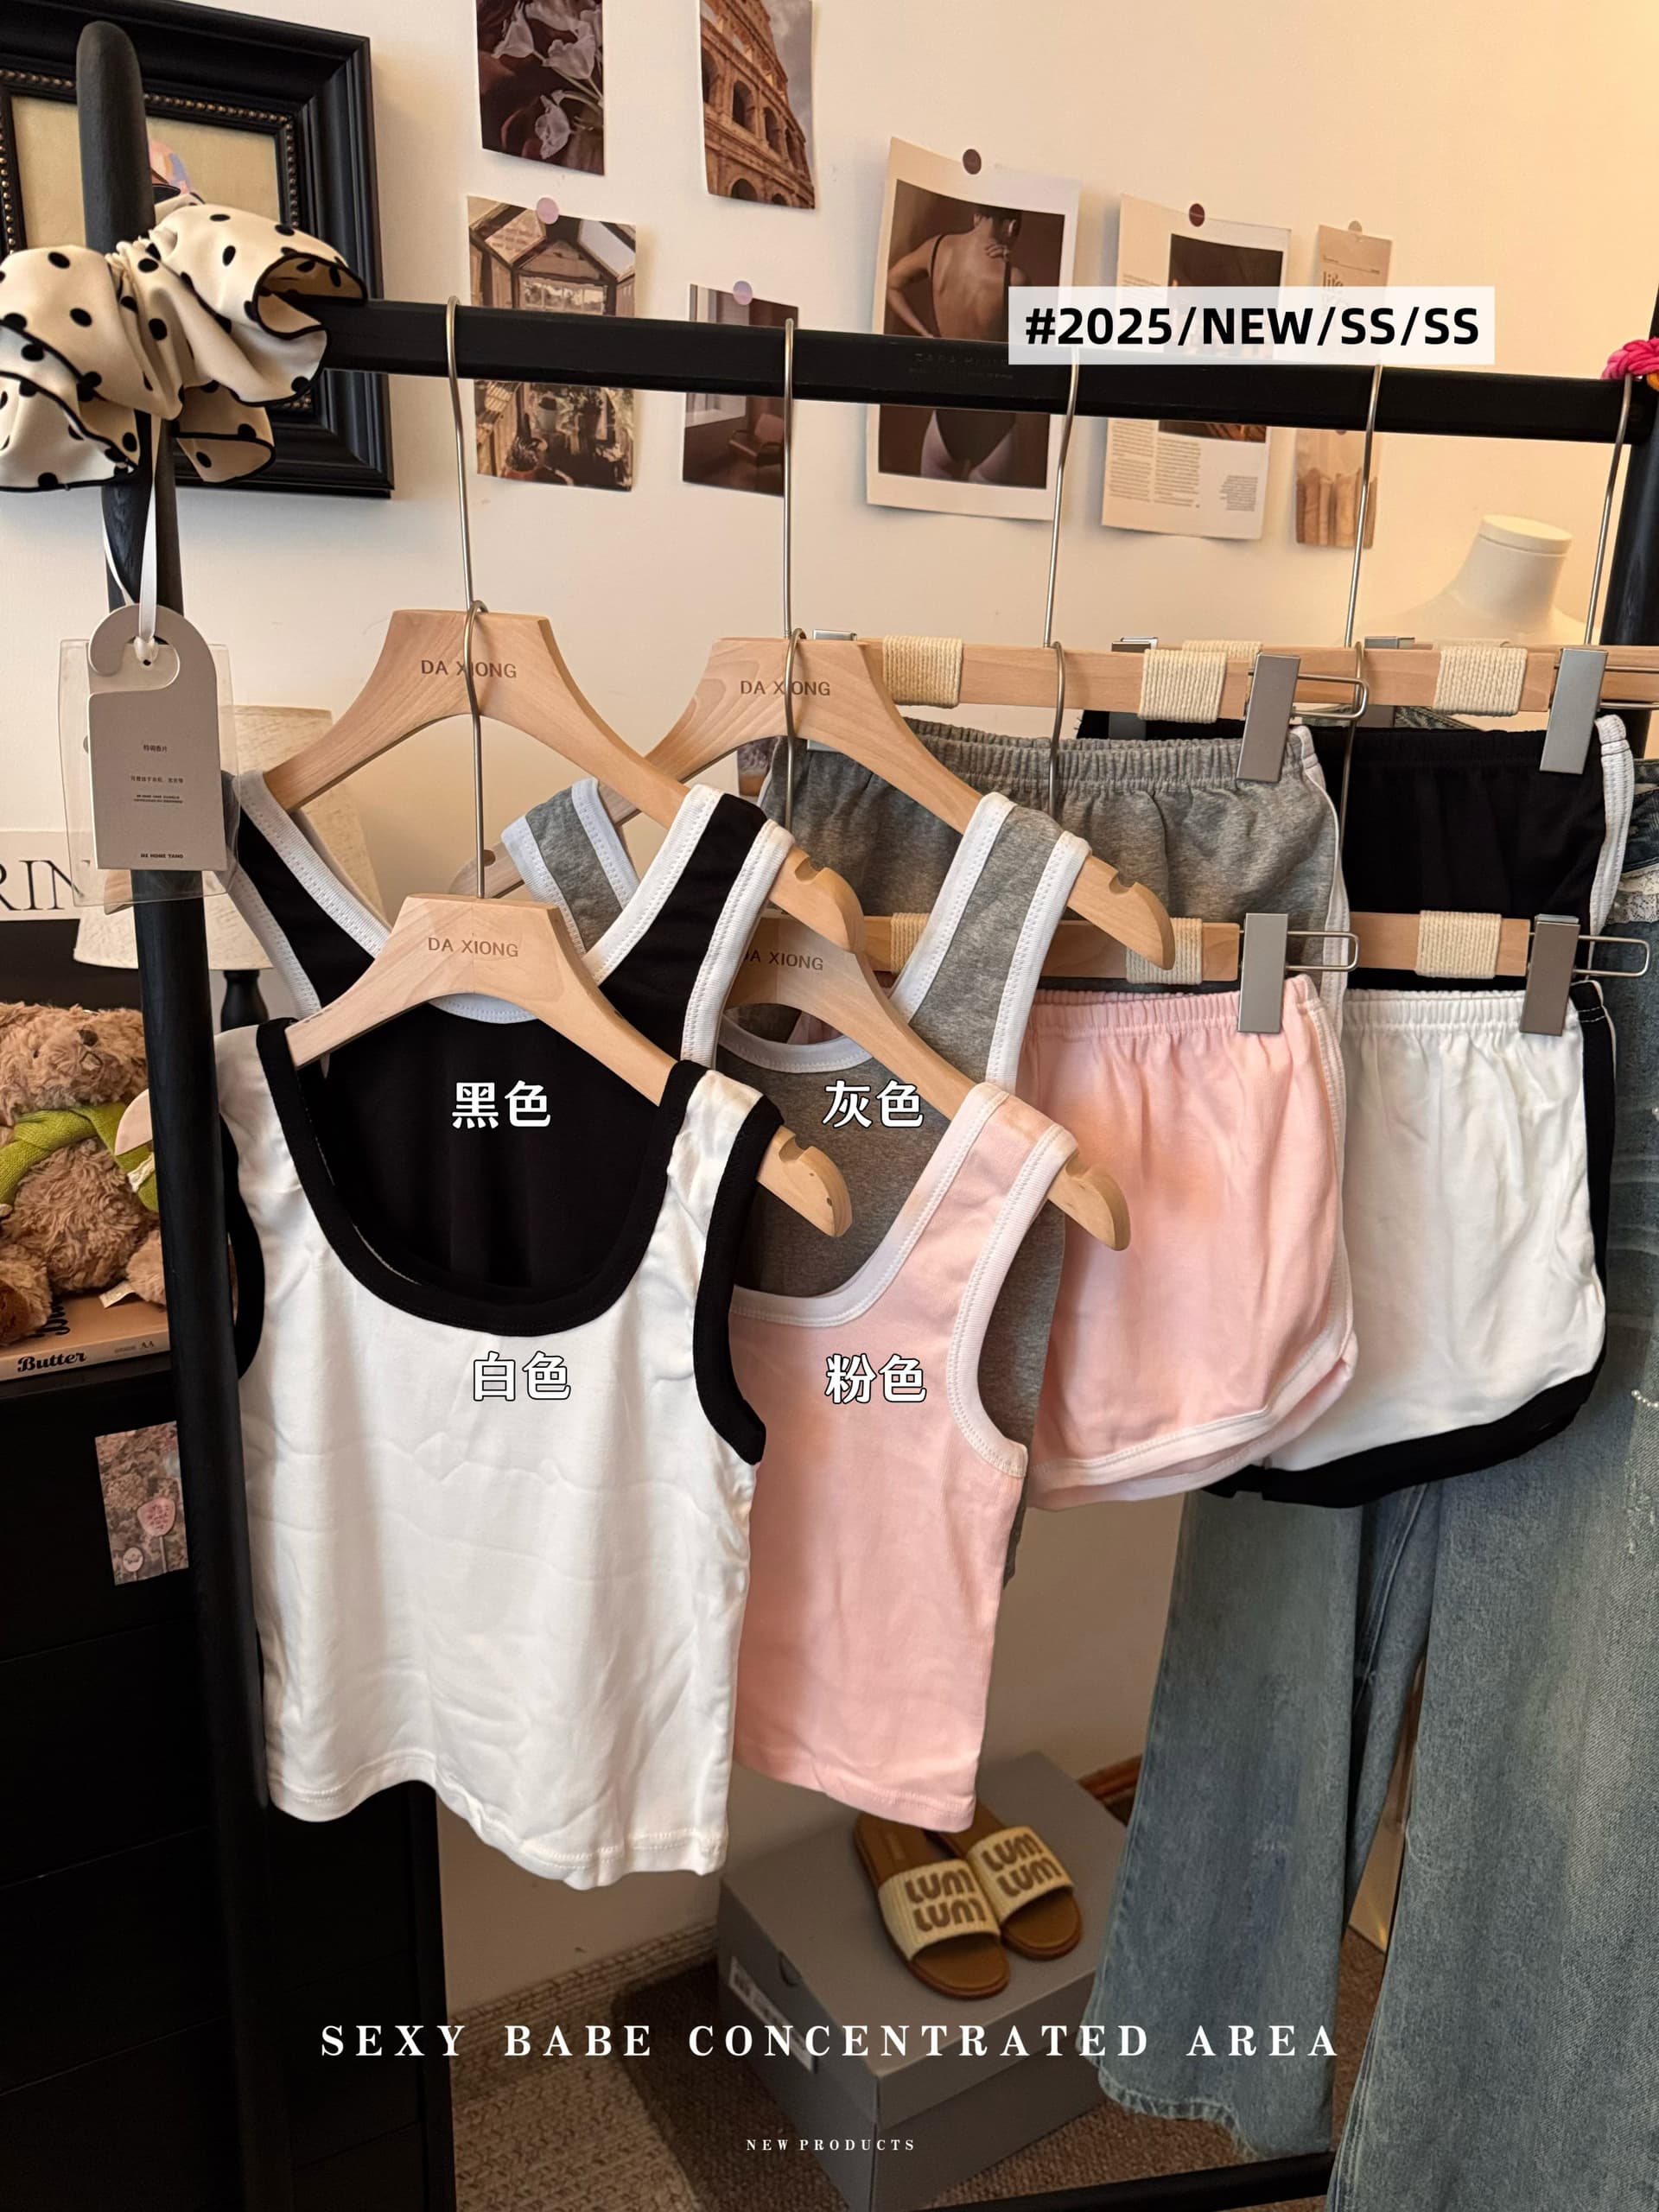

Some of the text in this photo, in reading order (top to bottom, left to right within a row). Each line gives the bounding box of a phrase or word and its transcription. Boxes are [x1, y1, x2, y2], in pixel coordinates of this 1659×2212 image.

[421, 659, 448, 676] DA
[741, 680, 830, 696] DA XONG
[428, 937, 519, 957] DA XIONG
[768, 951, 824, 971] XIONG
[17, 1351, 87, 1373] Butter
